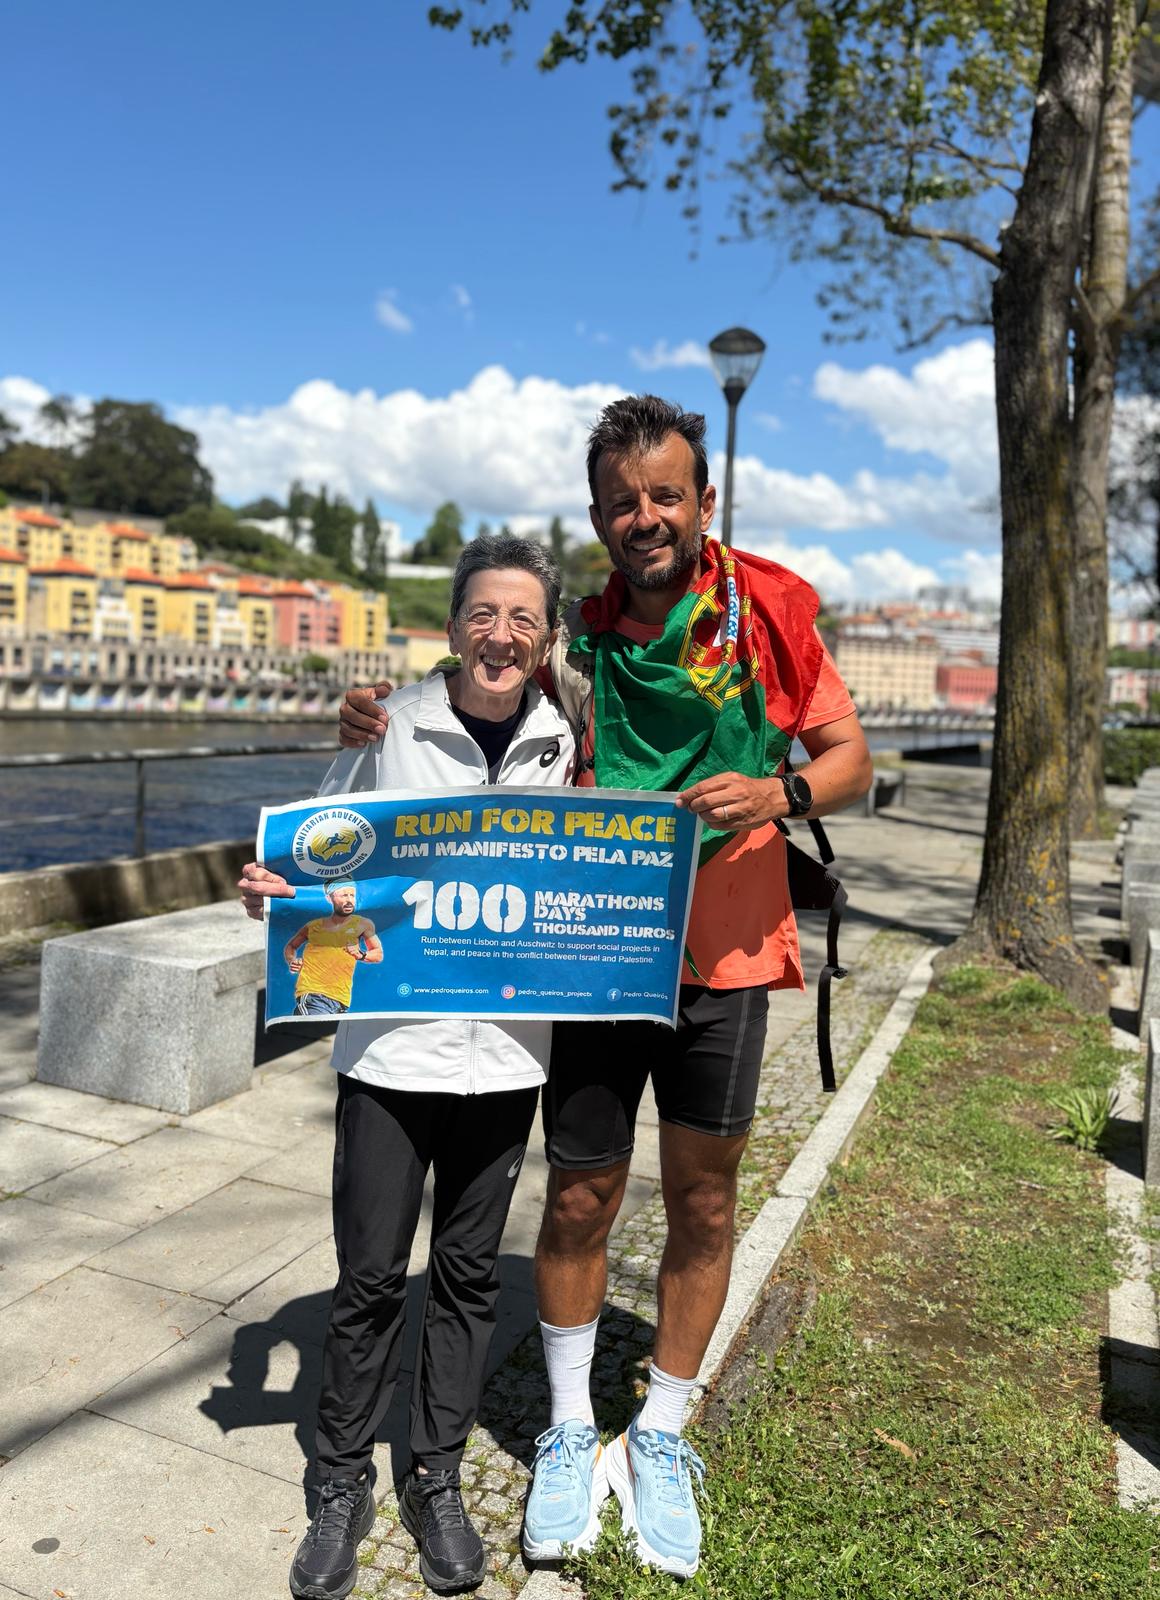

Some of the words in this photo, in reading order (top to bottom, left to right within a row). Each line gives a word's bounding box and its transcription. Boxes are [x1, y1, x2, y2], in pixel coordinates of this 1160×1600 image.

[331, 811, 373, 839] ADVENTURES
[395, 810, 472, 837] RUN
[481, 808, 555, 834] FOR
[565, 811, 676, 842] PEACE
[391, 843, 429, 858] UM
[435, 841, 567, 861] MANIFESTO
[573, 846, 627, 864] PELA
[631, 850, 674, 868] PAZ
[402, 880, 526, 933] 100
[534, 890, 665, 911] MARATHONS
[533, 904, 587, 921] DAYS
[533, 922, 620, 936] THOUSAND
[623, 926, 675, 940] EUROS
[421, 936, 437, 944] Run
[439, 936, 471, 945] between
[474, 938, 499, 946] Lisbon
[517, 940, 555, 948] Auschwitz
[557, 941, 565, 949] to
[567, 942, 595, 951] support
[621, 945, 651, 953] projects
[423, 948, 449, 957] Nepal,
[467, 951, 491, 959] peace
[493, 950, 500, 958] in
[502, 951, 514, 959] the
[516, 952, 543, 960] conflict
[544, 953, 577, 961] between
[579, 954, 600, 962] Israel
[618, 956, 655, 964] Palestine.
